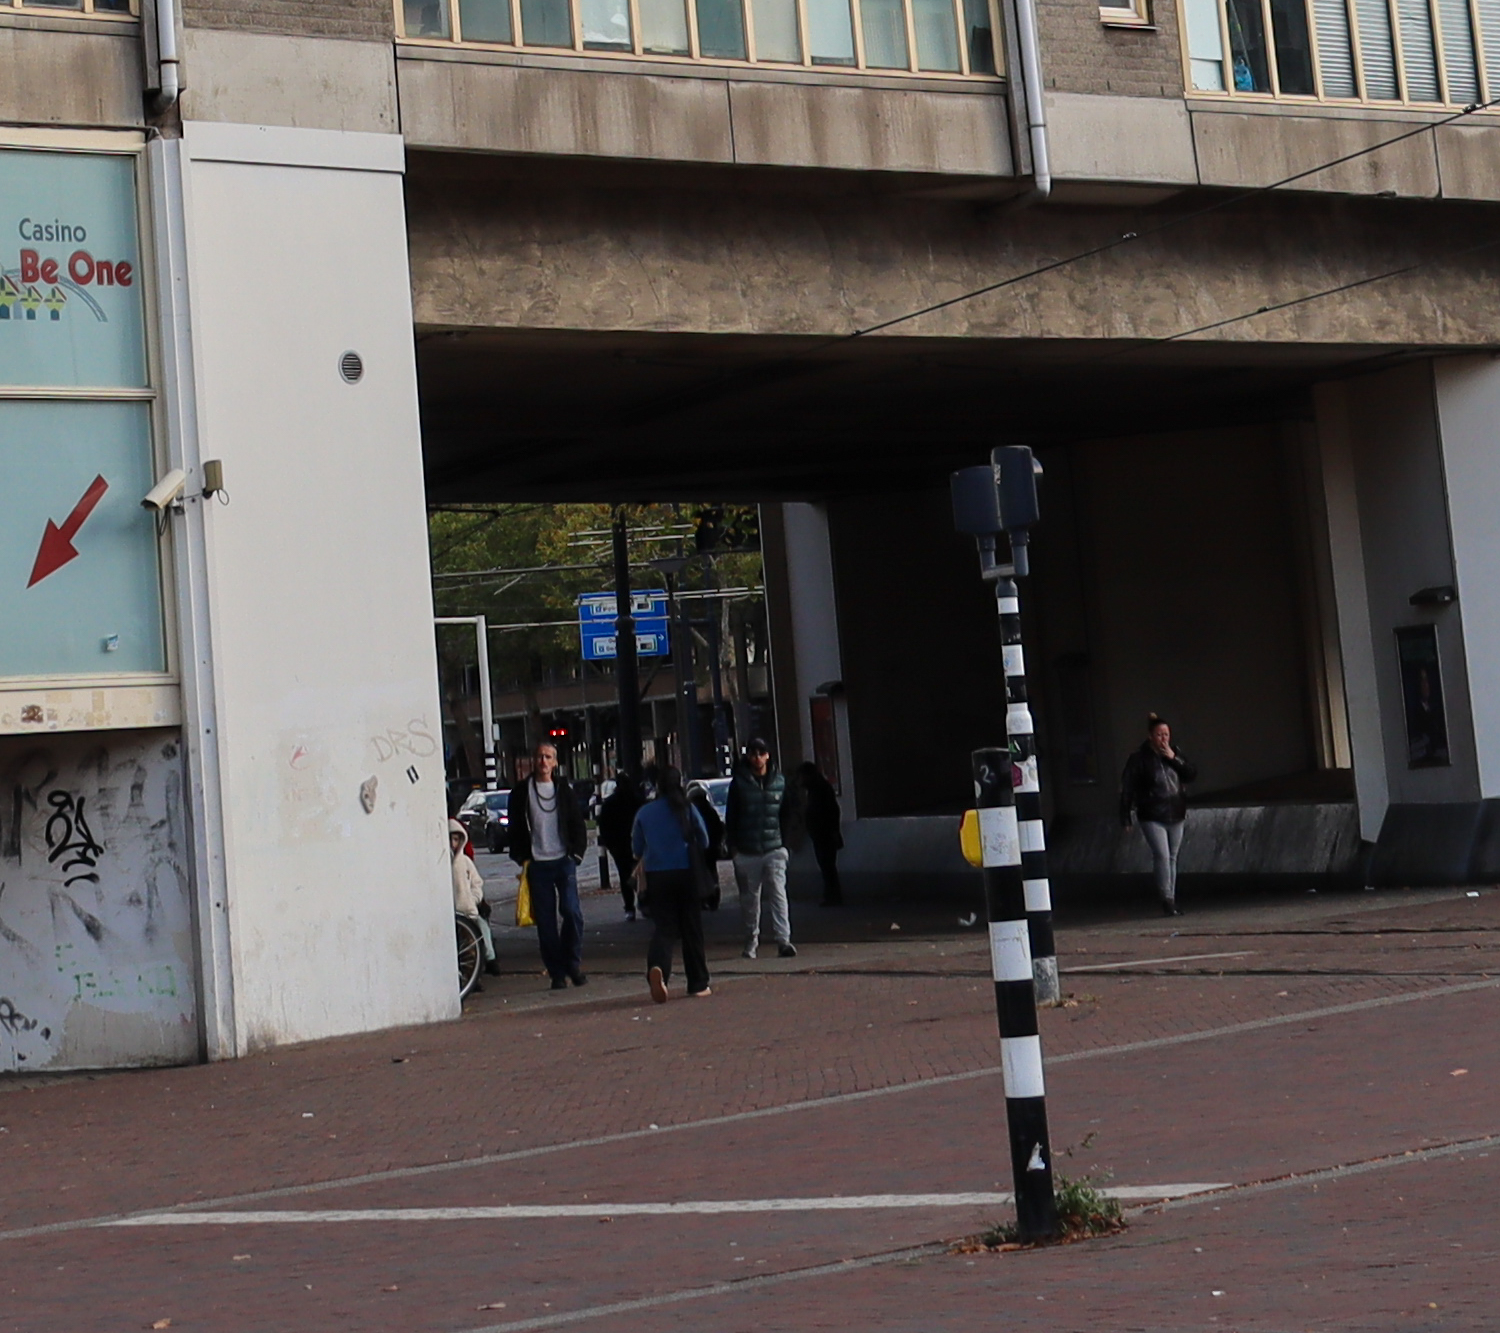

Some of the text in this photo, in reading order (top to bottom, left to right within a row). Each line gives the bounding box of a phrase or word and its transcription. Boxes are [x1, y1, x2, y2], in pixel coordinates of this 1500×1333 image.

[19, 217, 87, 242] Casino
[20, 248, 133, 287] Be One
